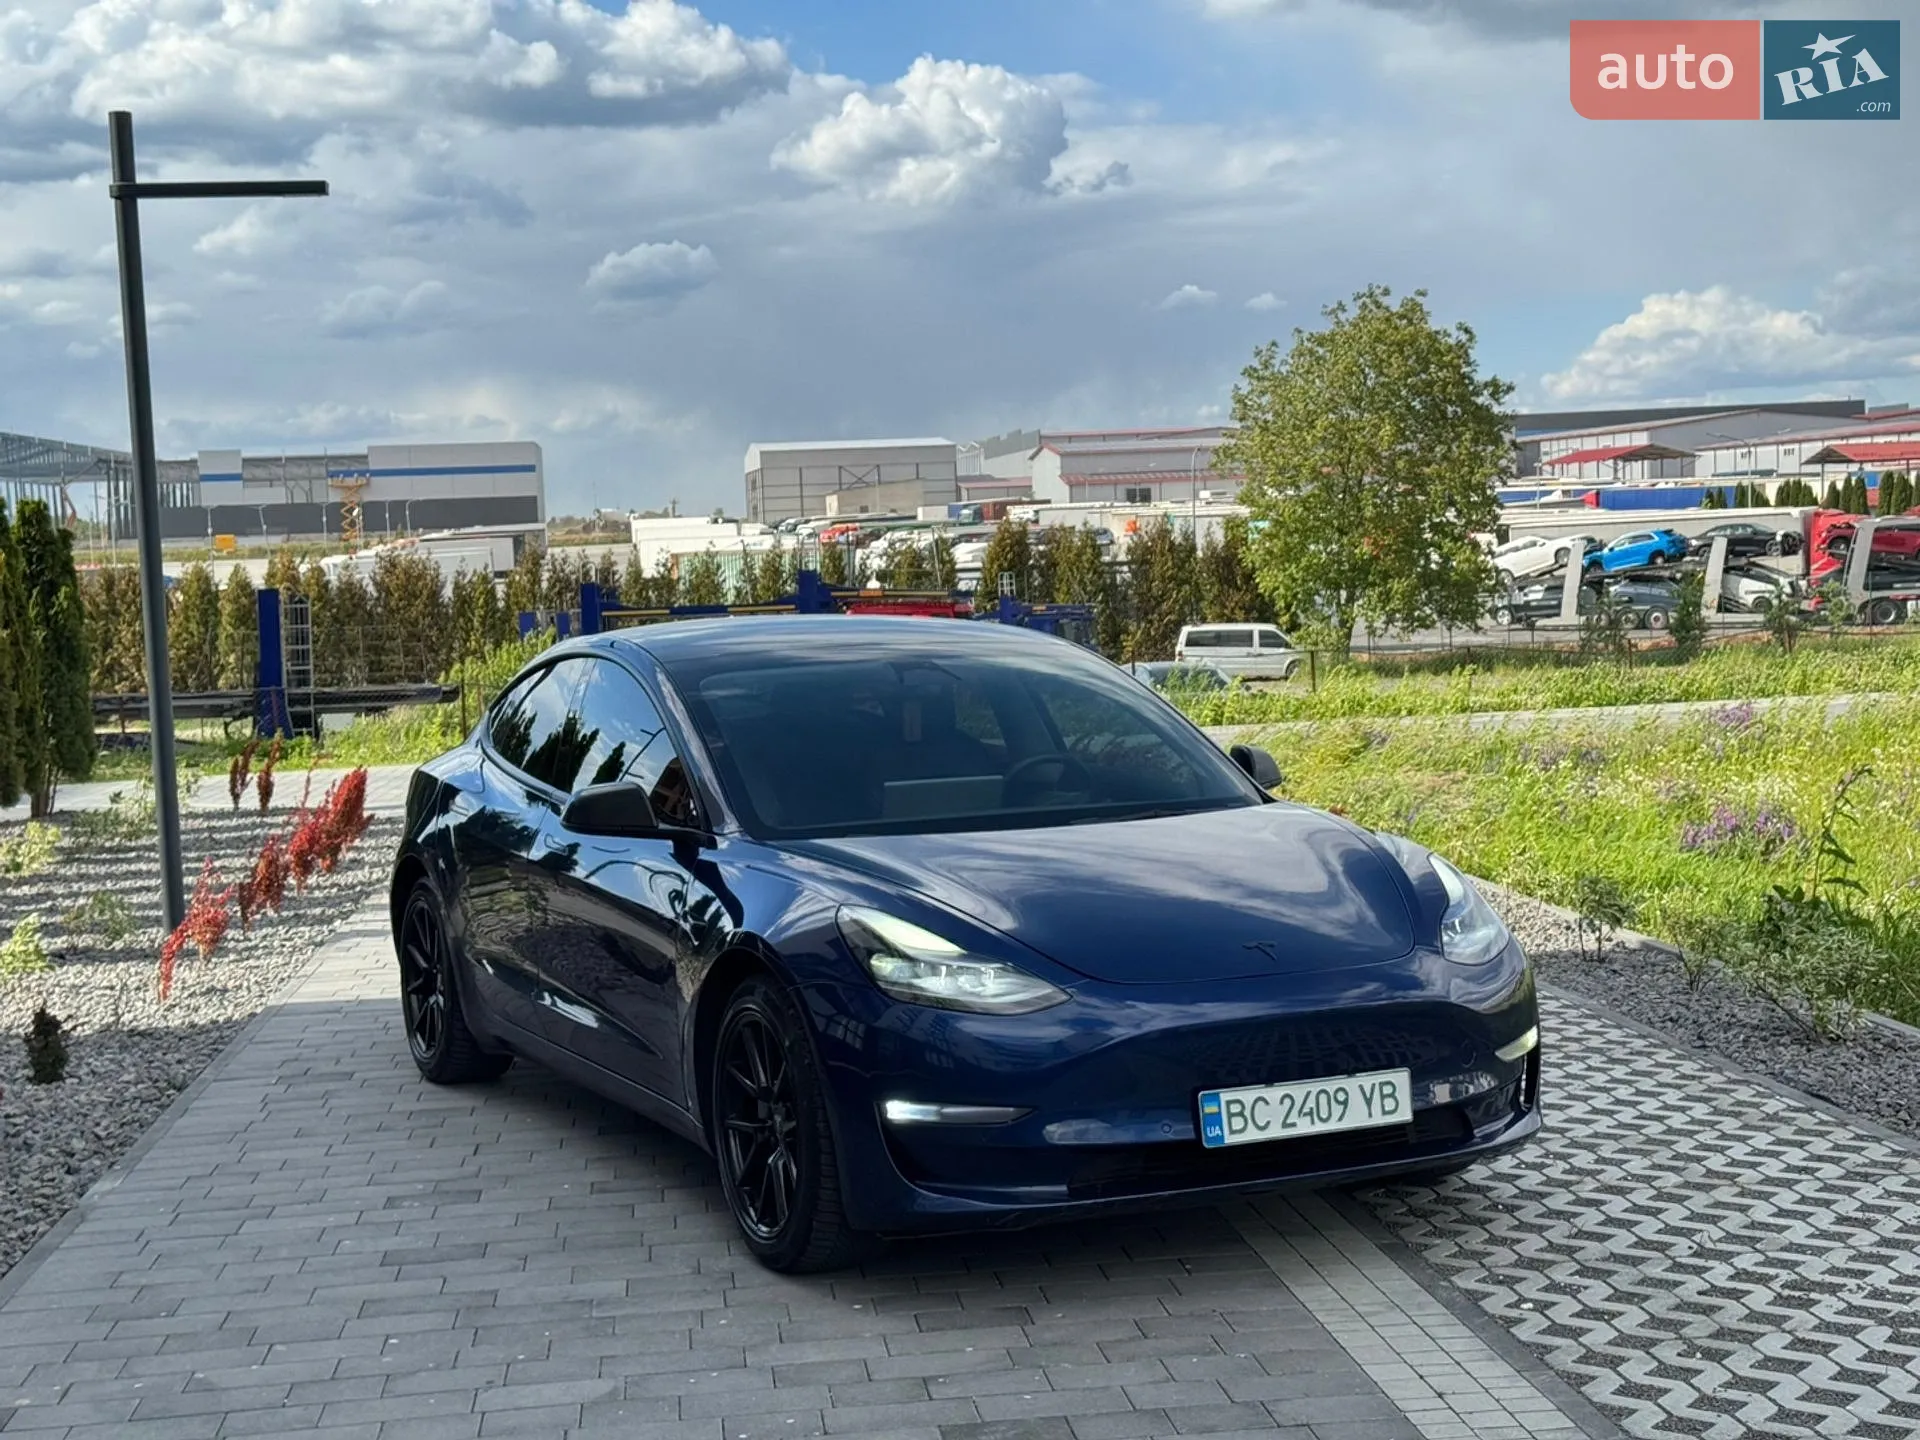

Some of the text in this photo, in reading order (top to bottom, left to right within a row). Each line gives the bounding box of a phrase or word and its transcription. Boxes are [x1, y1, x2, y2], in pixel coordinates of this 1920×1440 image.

[1225, 1080, 1400, 1135] BC 2409 YB
[1207, 1125, 1222, 1137] UA
